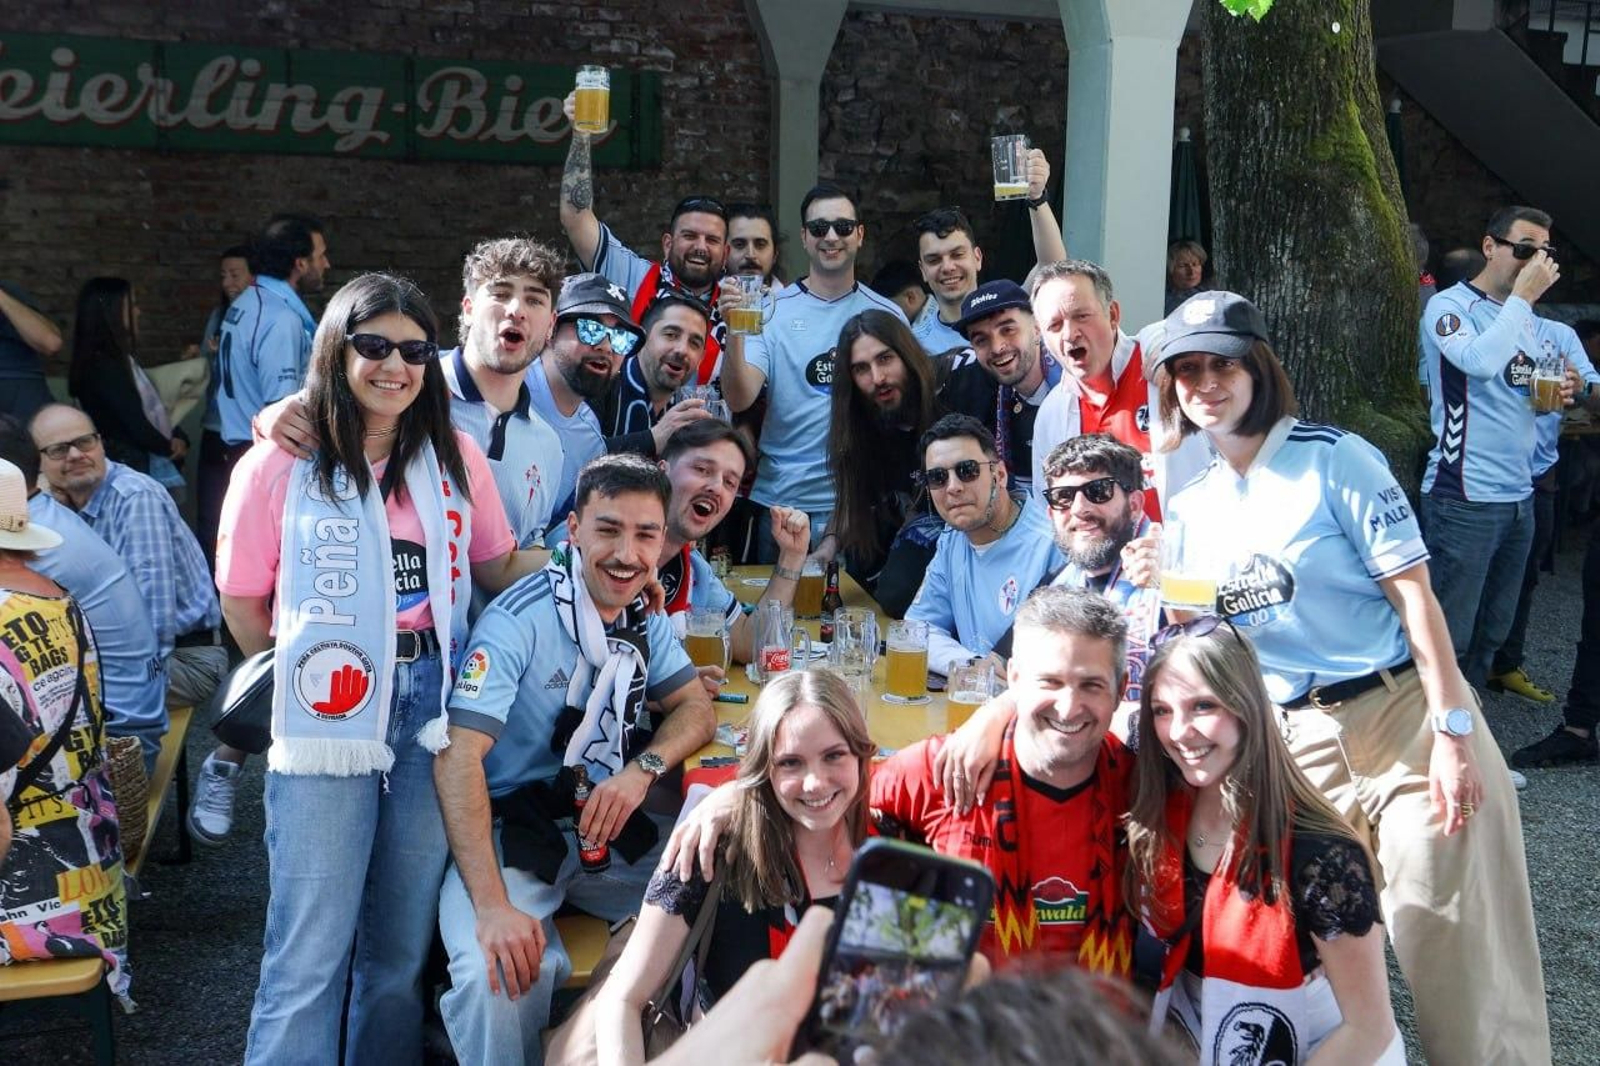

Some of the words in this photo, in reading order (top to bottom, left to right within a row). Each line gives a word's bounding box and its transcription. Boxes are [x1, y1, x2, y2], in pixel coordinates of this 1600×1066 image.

[299, 516, 360, 627] Peña
[1223, 585, 1284, 615] Galicia
[29, 646, 69, 679] BAGS
